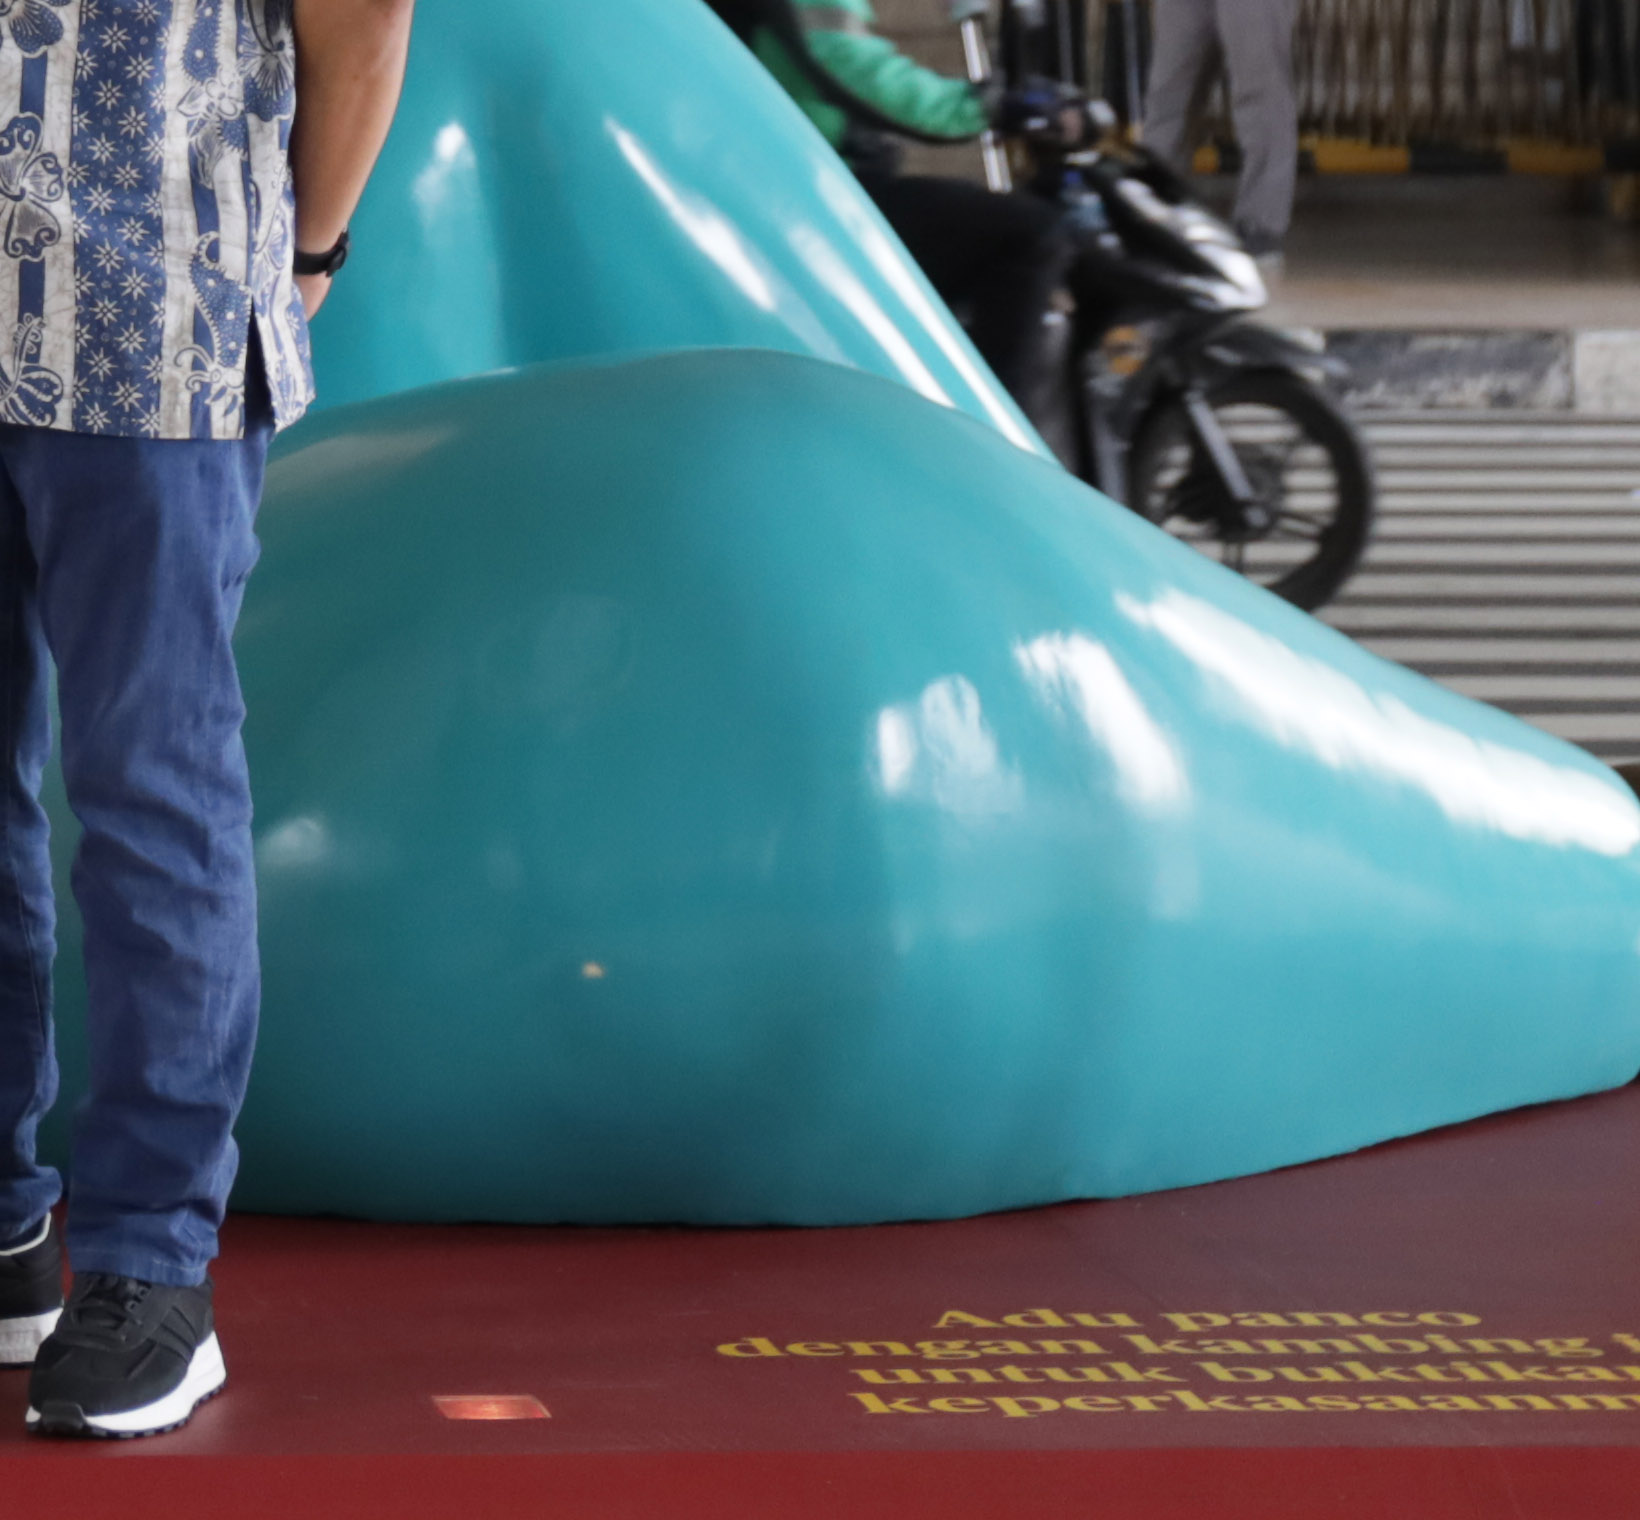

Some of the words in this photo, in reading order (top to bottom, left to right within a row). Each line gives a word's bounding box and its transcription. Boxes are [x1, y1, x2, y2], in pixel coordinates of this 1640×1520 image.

[931, 1308, 1144, 1329] Adu
[1161, 1311, 1482, 1332] panco
[716, 1337, 1111, 1360] dengan
[1120, 1333, 1604, 1358] kambing
[848, 1361, 1188, 1384] untuk
